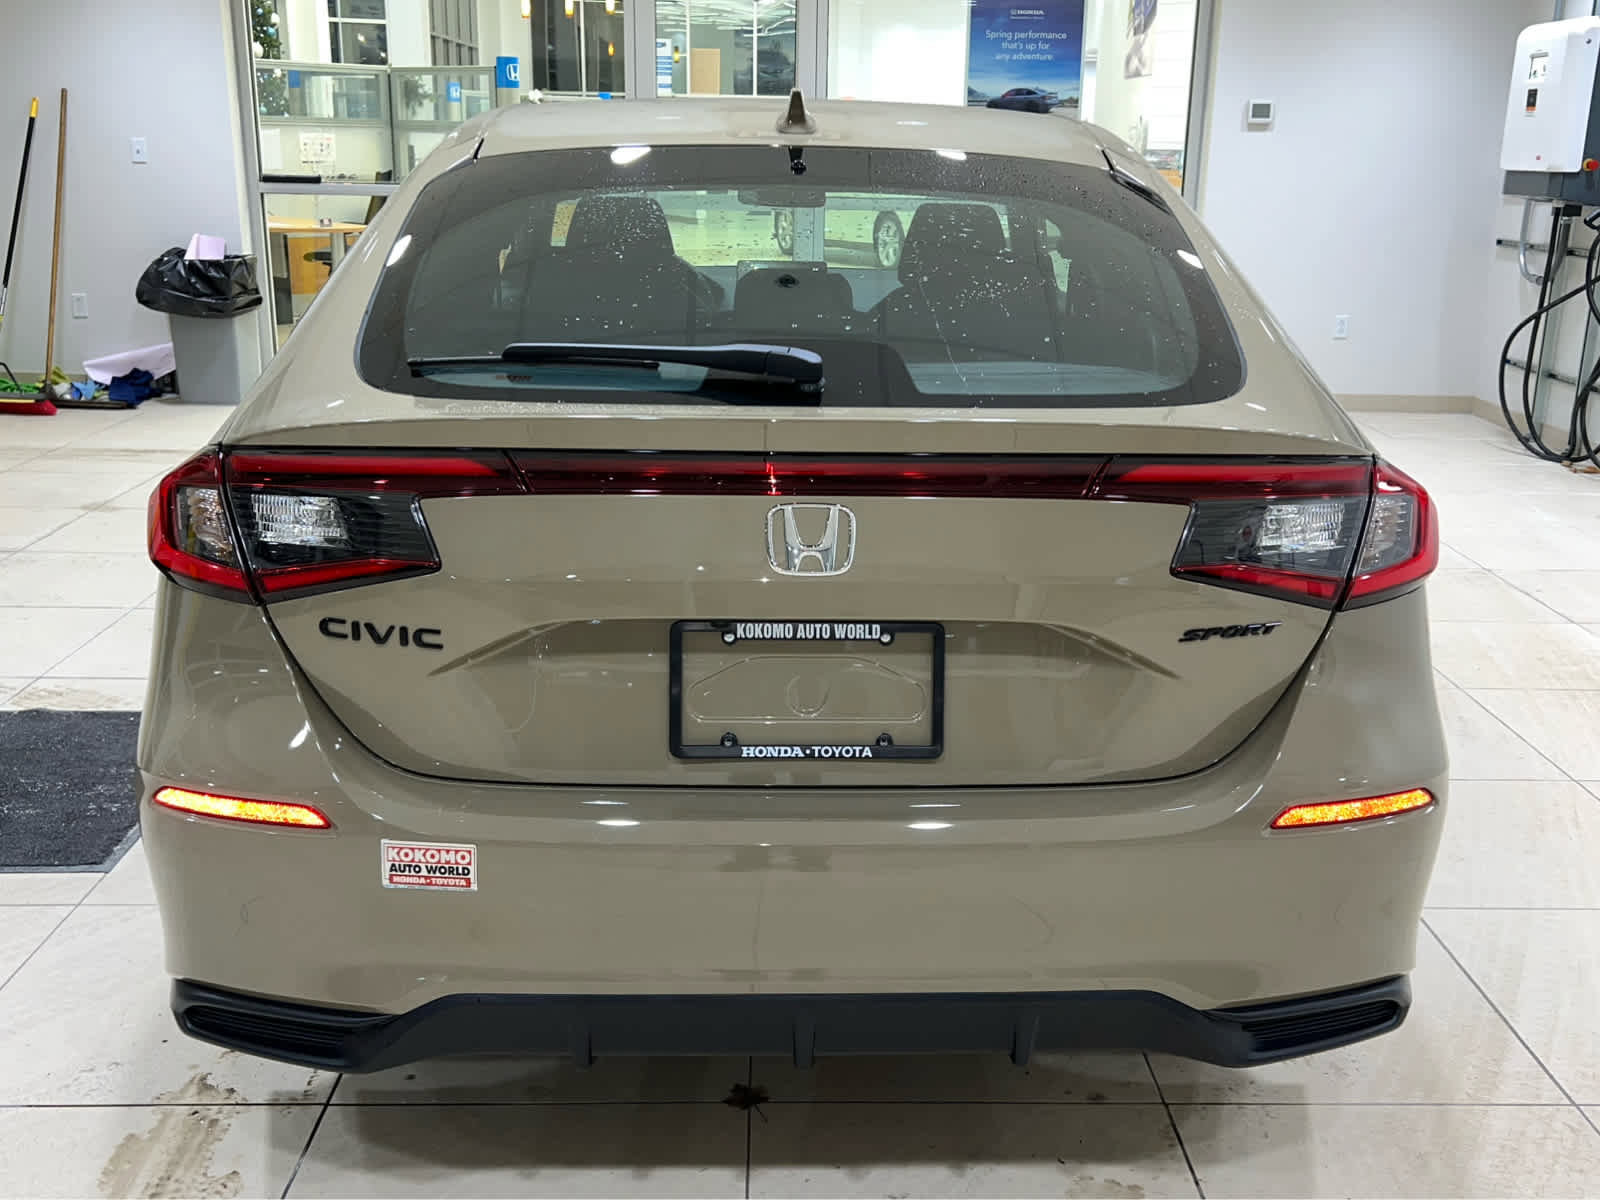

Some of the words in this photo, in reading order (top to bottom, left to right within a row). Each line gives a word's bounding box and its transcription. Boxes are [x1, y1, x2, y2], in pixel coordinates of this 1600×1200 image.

[985, 30, 1012, 40] Spring
[1014, 30, 1067, 40] performance
[1002, 41, 1023, 49] that's
[1038, 41, 1050, 49] for
[995, 54, 1009, 62] any
[319, 616, 443, 650] CIVIC
[736, 623, 793, 639] KOKOMO
[797, 624, 831, 639] AUTO
[835, 624, 881, 640] WORLD
[1178, 621, 1282, 642] SPORT
[387, 847, 471, 864] KOKOMO
[389, 863, 422, 874] AUTO
[425, 865, 471, 877] WORLD
